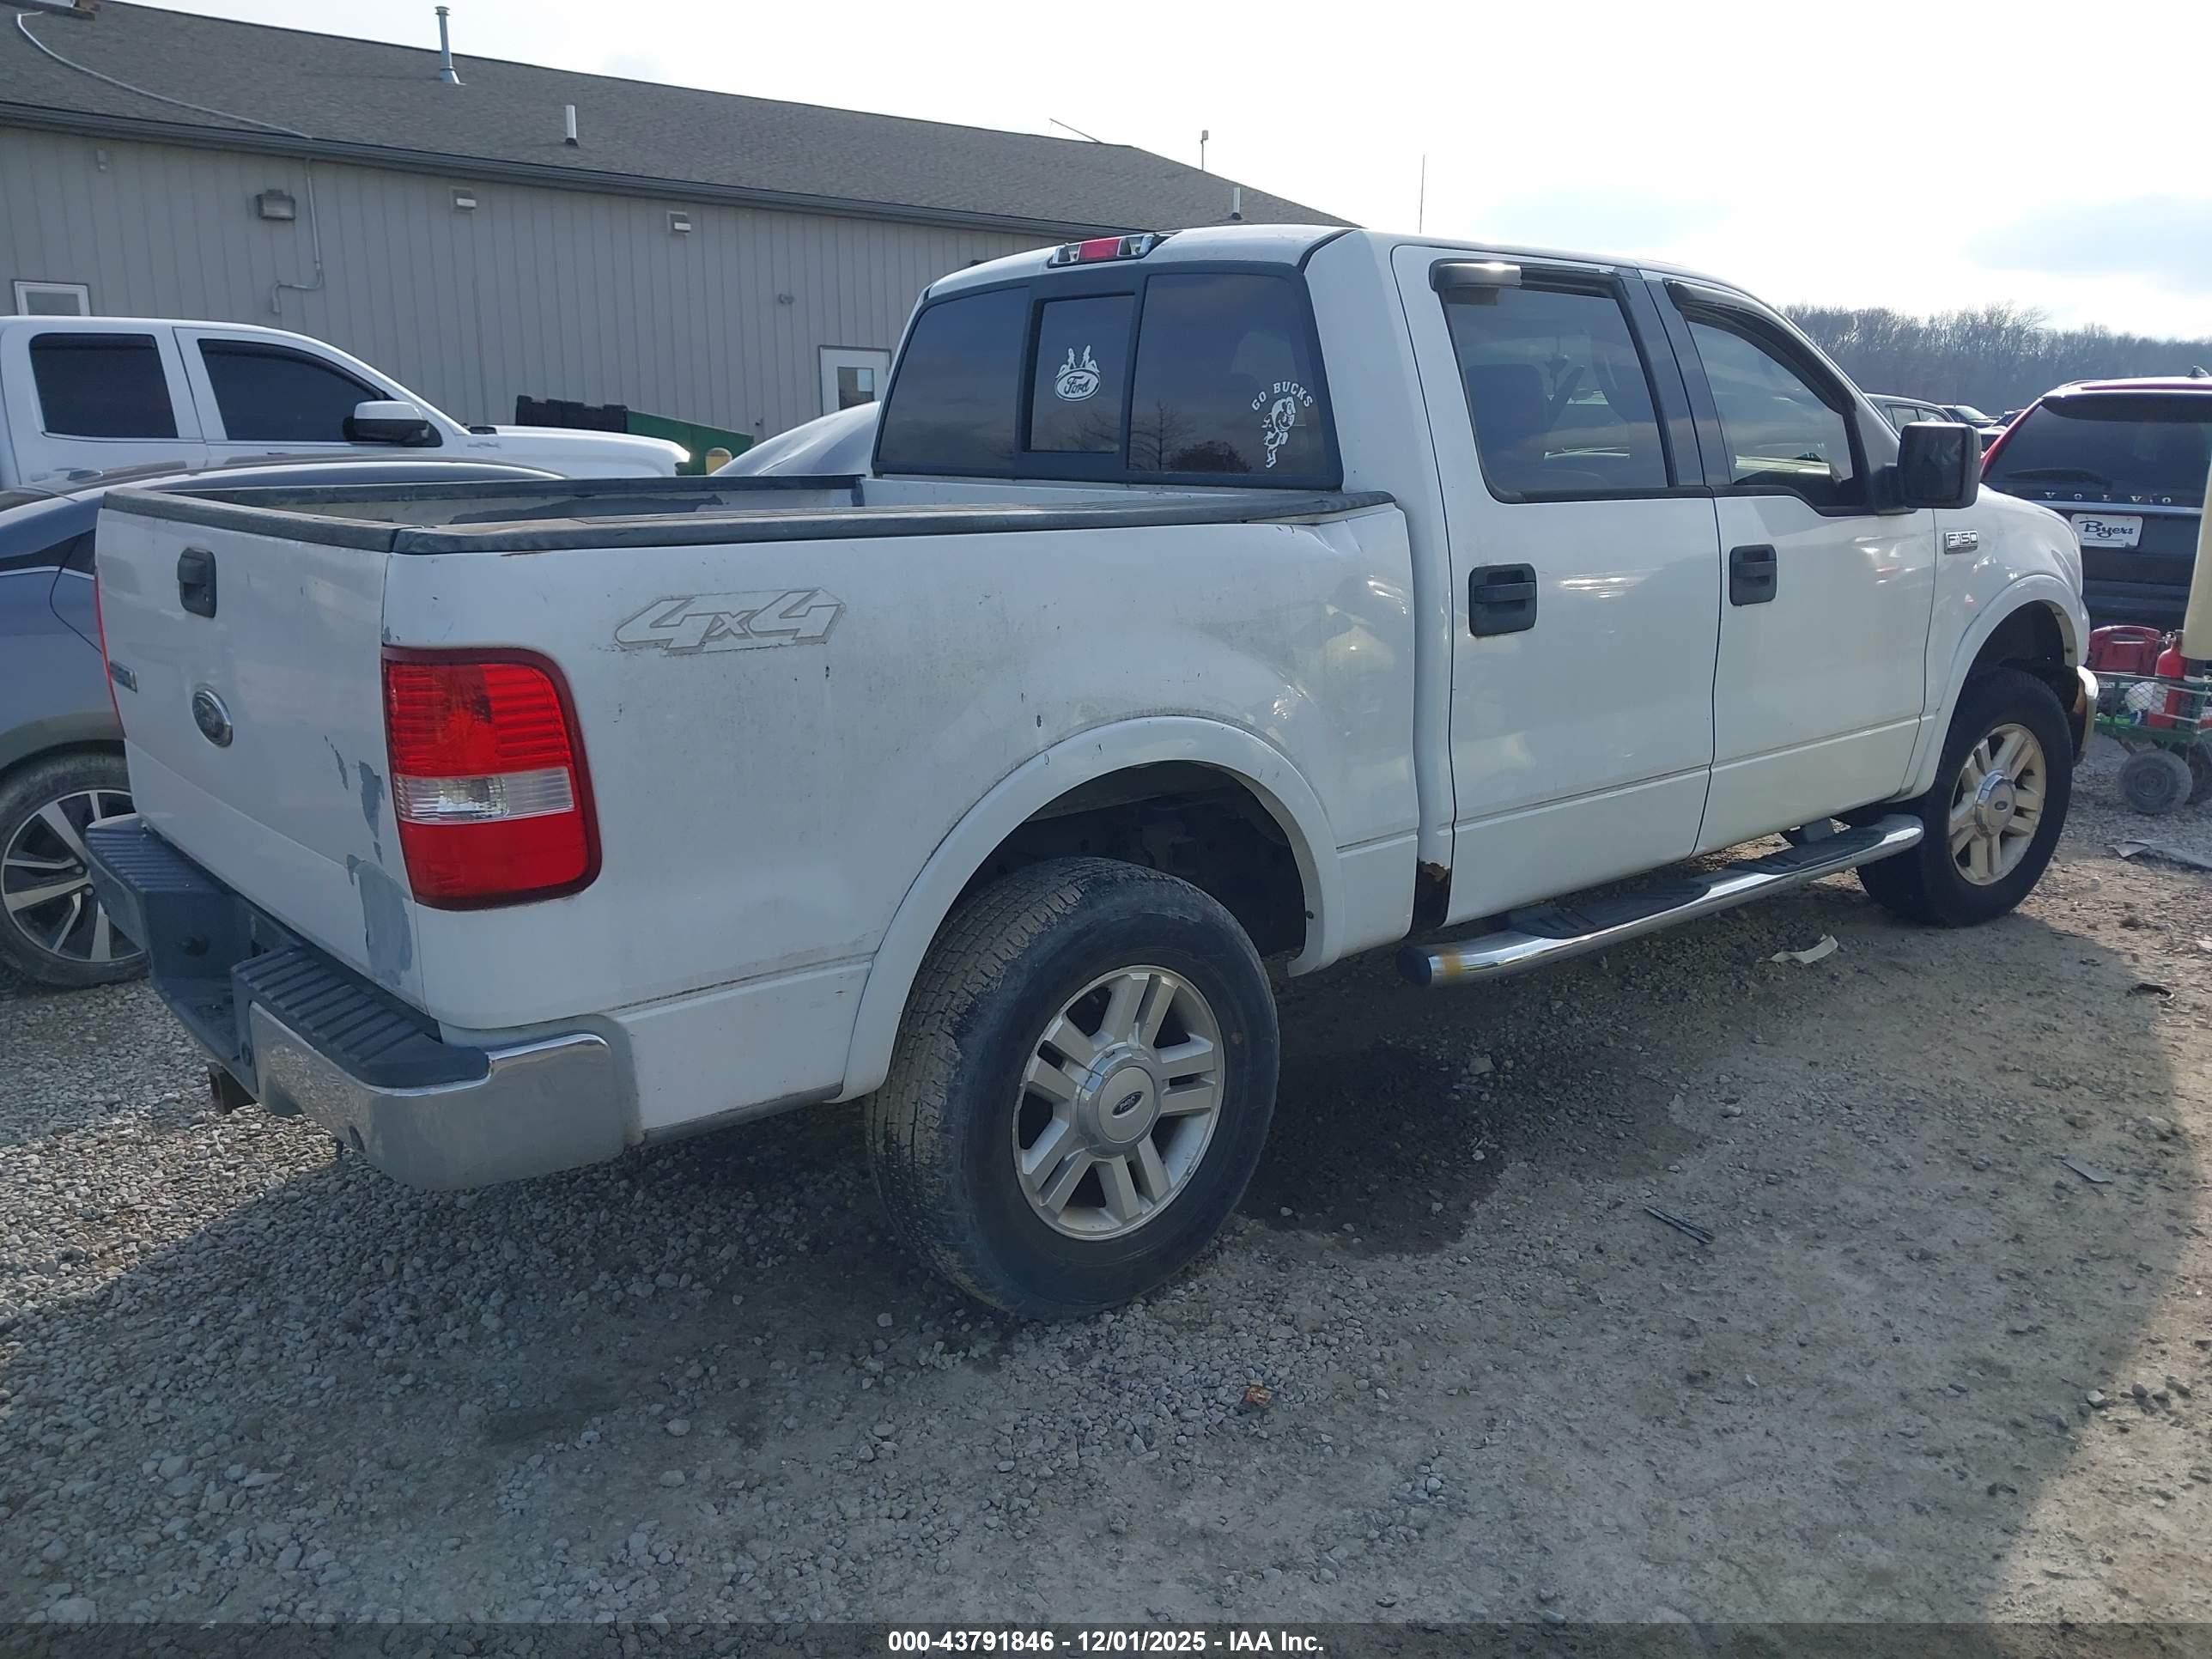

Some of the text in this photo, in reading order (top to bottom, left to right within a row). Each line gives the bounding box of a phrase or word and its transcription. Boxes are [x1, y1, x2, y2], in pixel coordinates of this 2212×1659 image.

[1064, 374, 1091, 395] Ford
[1251, 381, 1313, 410] GO BUCKS
[2044, 491, 2172, 504] VOLVO
[2078, 520, 2134, 538] Byers
